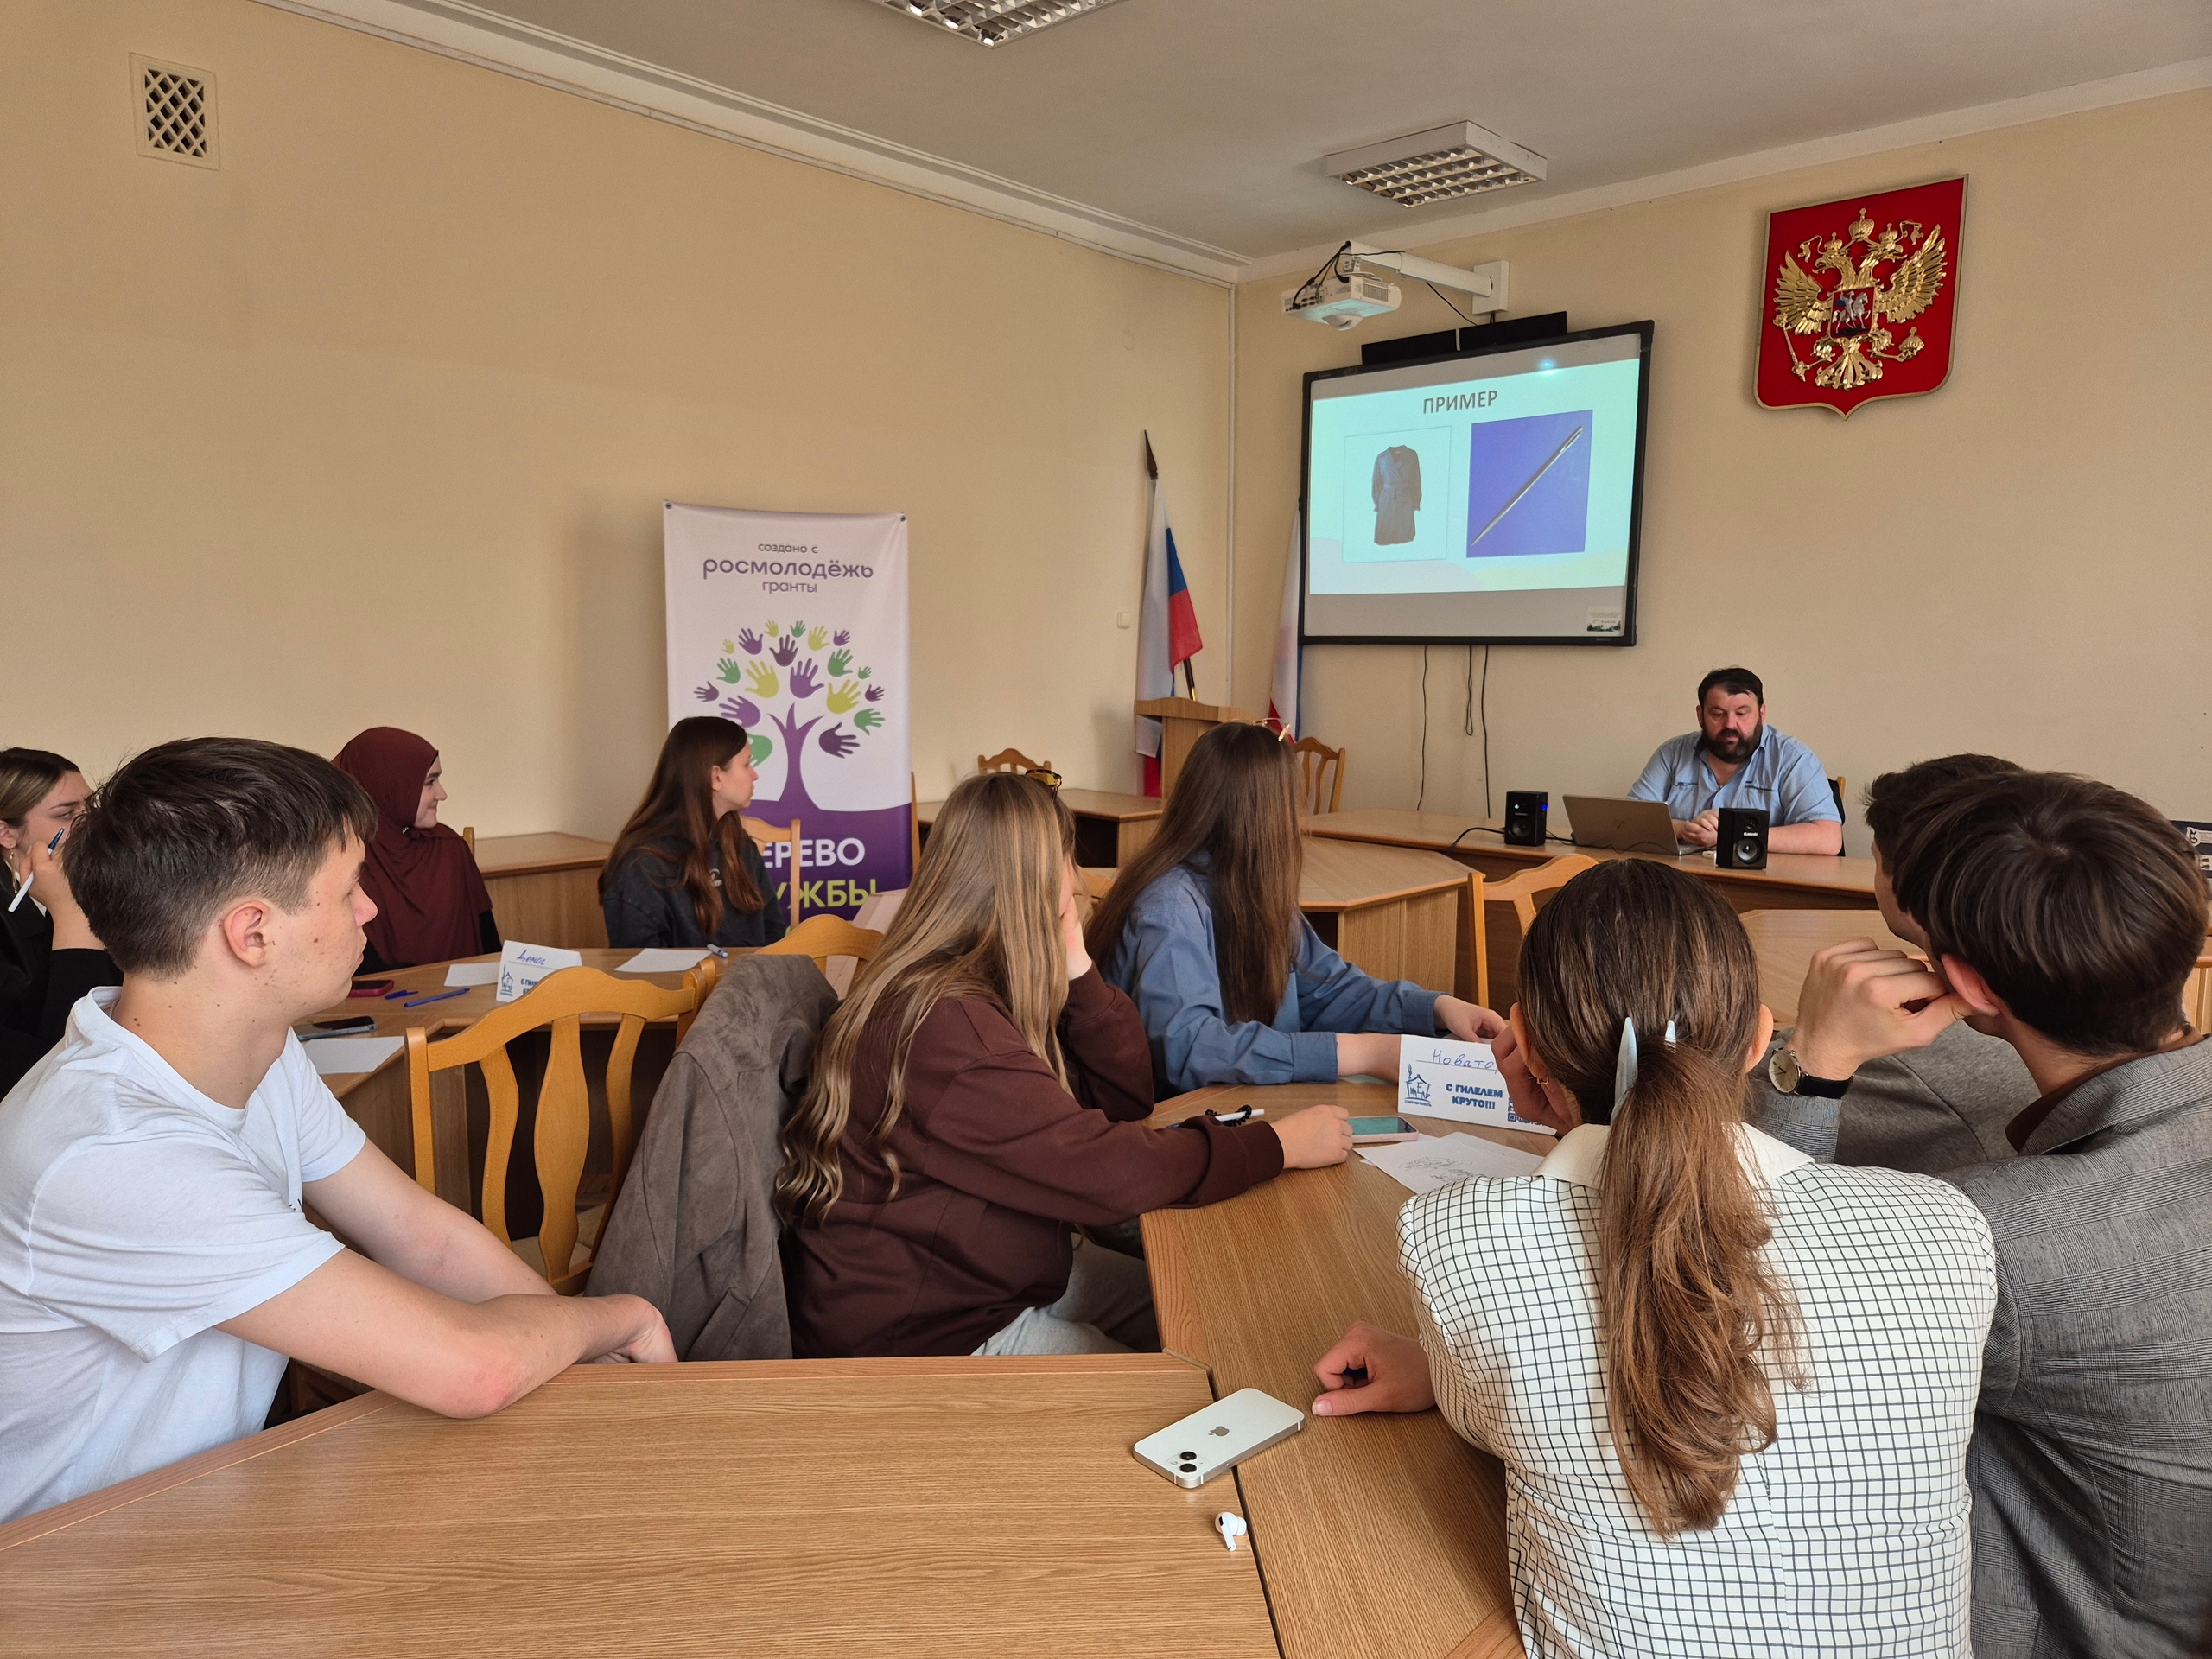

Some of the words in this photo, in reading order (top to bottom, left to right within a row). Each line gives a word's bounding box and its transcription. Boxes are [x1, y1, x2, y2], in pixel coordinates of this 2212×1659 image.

[1423, 390, 1498, 414] ПРИМЕР
[758, 543, 808, 554] создано
[703, 558, 874, 580] росмолодёжь
[762, 582, 817, 594] гранты
[763, 837, 865, 868] ЕРЕВО
[1432, 1048, 1499, 1074] Новато
[1446, 1083, 1453, 1092] С
[1455, 1084, 1503, 1098] ГИЛЕЛЕМ
[1452, 1096, 1496, 1109] КРУТО!!!
